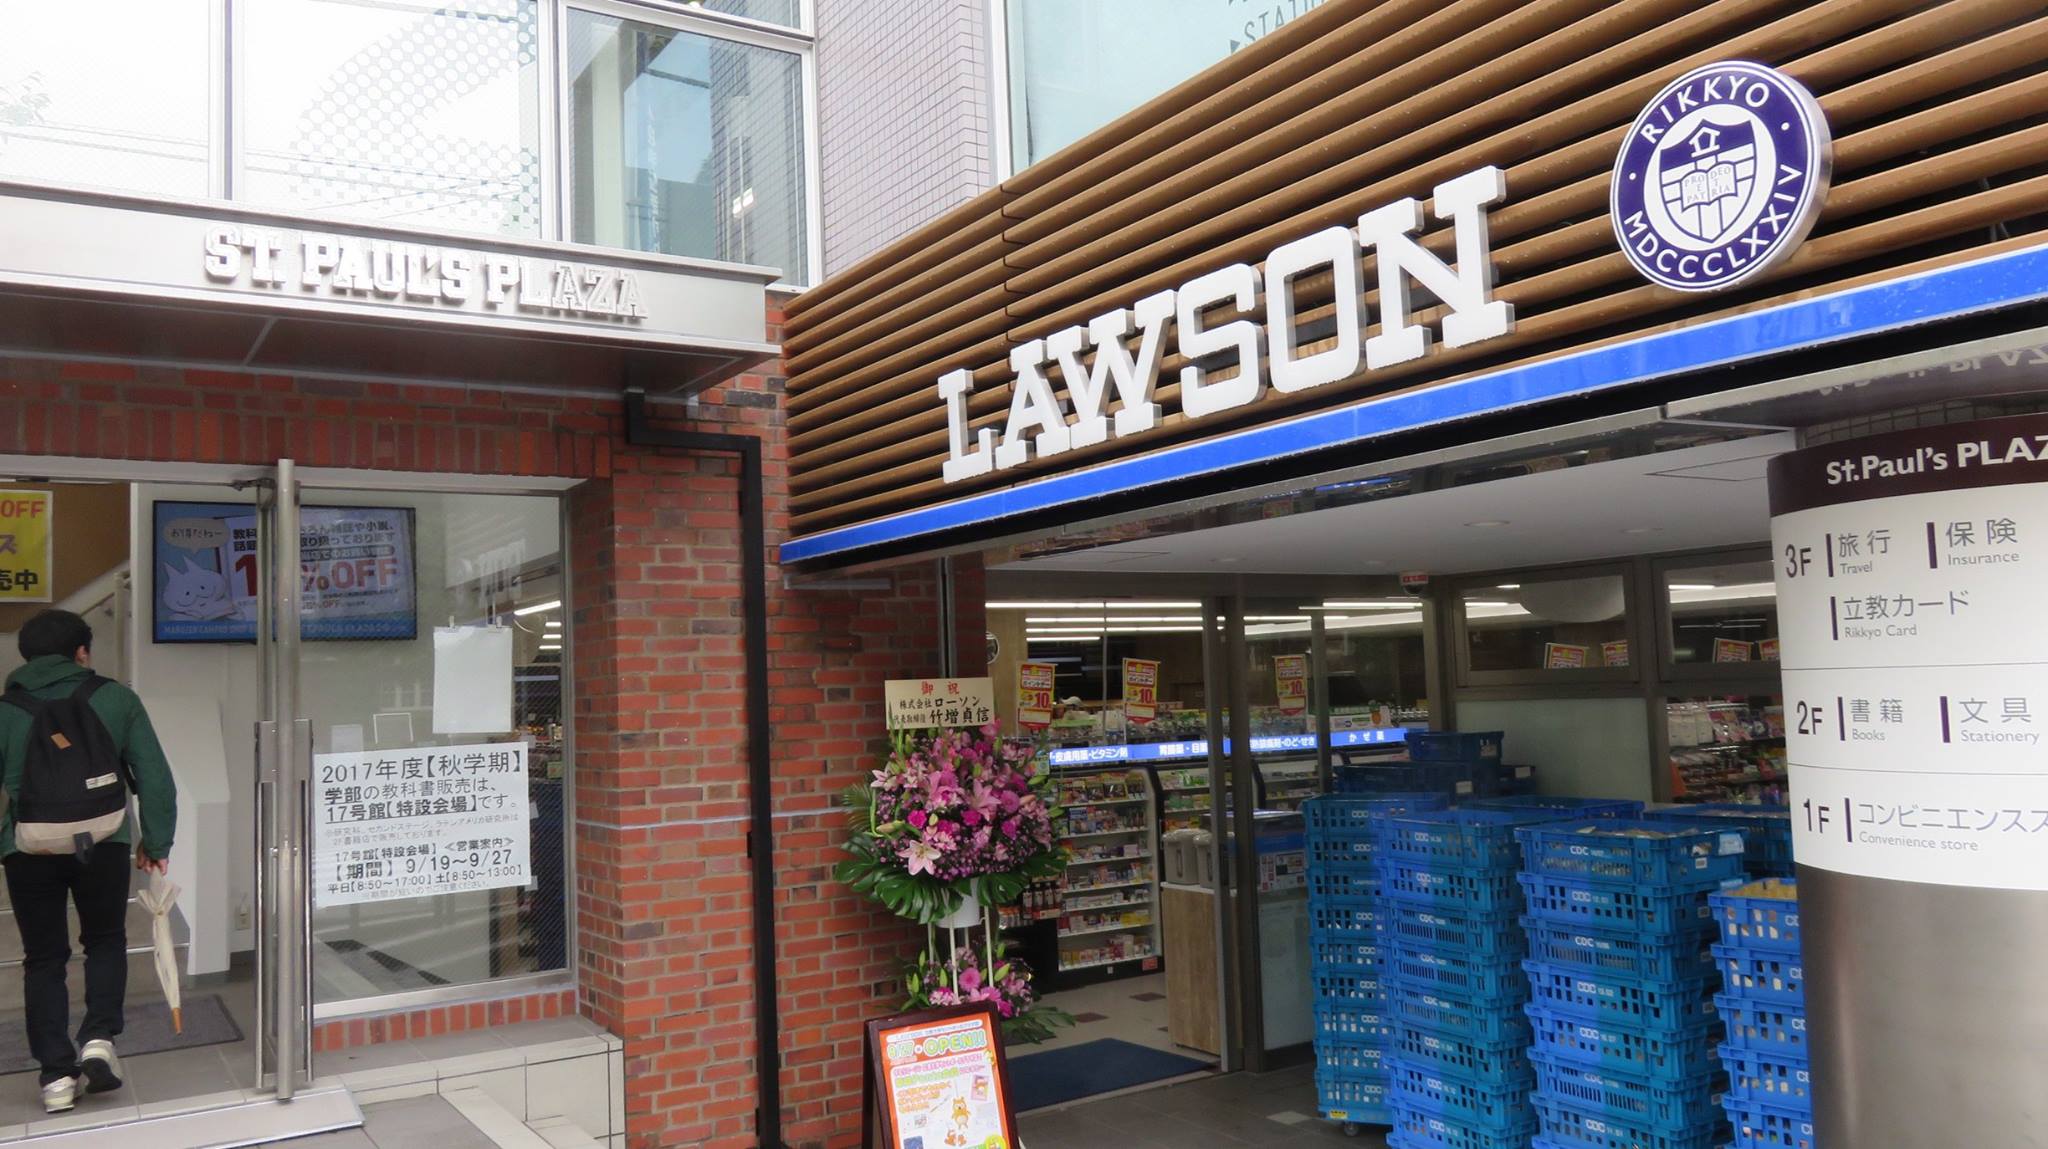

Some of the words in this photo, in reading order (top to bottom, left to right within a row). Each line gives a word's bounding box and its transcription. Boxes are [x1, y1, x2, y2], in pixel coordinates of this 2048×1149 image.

[1640, 75, 1770, 144] RIKKYO
[1624, 164, 1802, 278] MDCCCLXXIV
[205, 225, 287, 284] ST.
[302, 232, 472, 299] PAUL'S
[485, 255, 648, 320] PLAZA
[938, 165, 1515, 483] LAWSON
[1838, 529, 1891, 558] 旅行
[1946, 518, 2018, 548] 保険
[1785, 544, 1812, 578] 3F
[1840, 562, 1873, 576] Travel
[1948, 551, 2020, 566] Insurance
[1843, 590, 1969, 620] 立教カード
[1844, 626, 1882, 640] Rikkyo
[1886, 624, 1917, 637] Card
[921, 681, 959, 696] 御祝
[1797, 700, 1823, 735] 2F
[1850, 698, 1903, 724] 書籍
[1959, 697, 2032, 724] 文具
[1852, 728, 1886, 741] Books
[1961, 729, 2040, 745] Stationery
[322, 750, 521, 783] 2017年度【秋学期】
[325, 777, 497, 804] 学部の教科書販売は、
[326, 793, 516, 822] 17号館【特設会場】です。
[1803, 798, 1830, 833] 1F
[1570, 845, 1589, 855] CDC
[1859, 831, 1936, 849] Convenience
[1941, 840, 1979, 851] store
[1575, 936, 1595, 947] CDC
